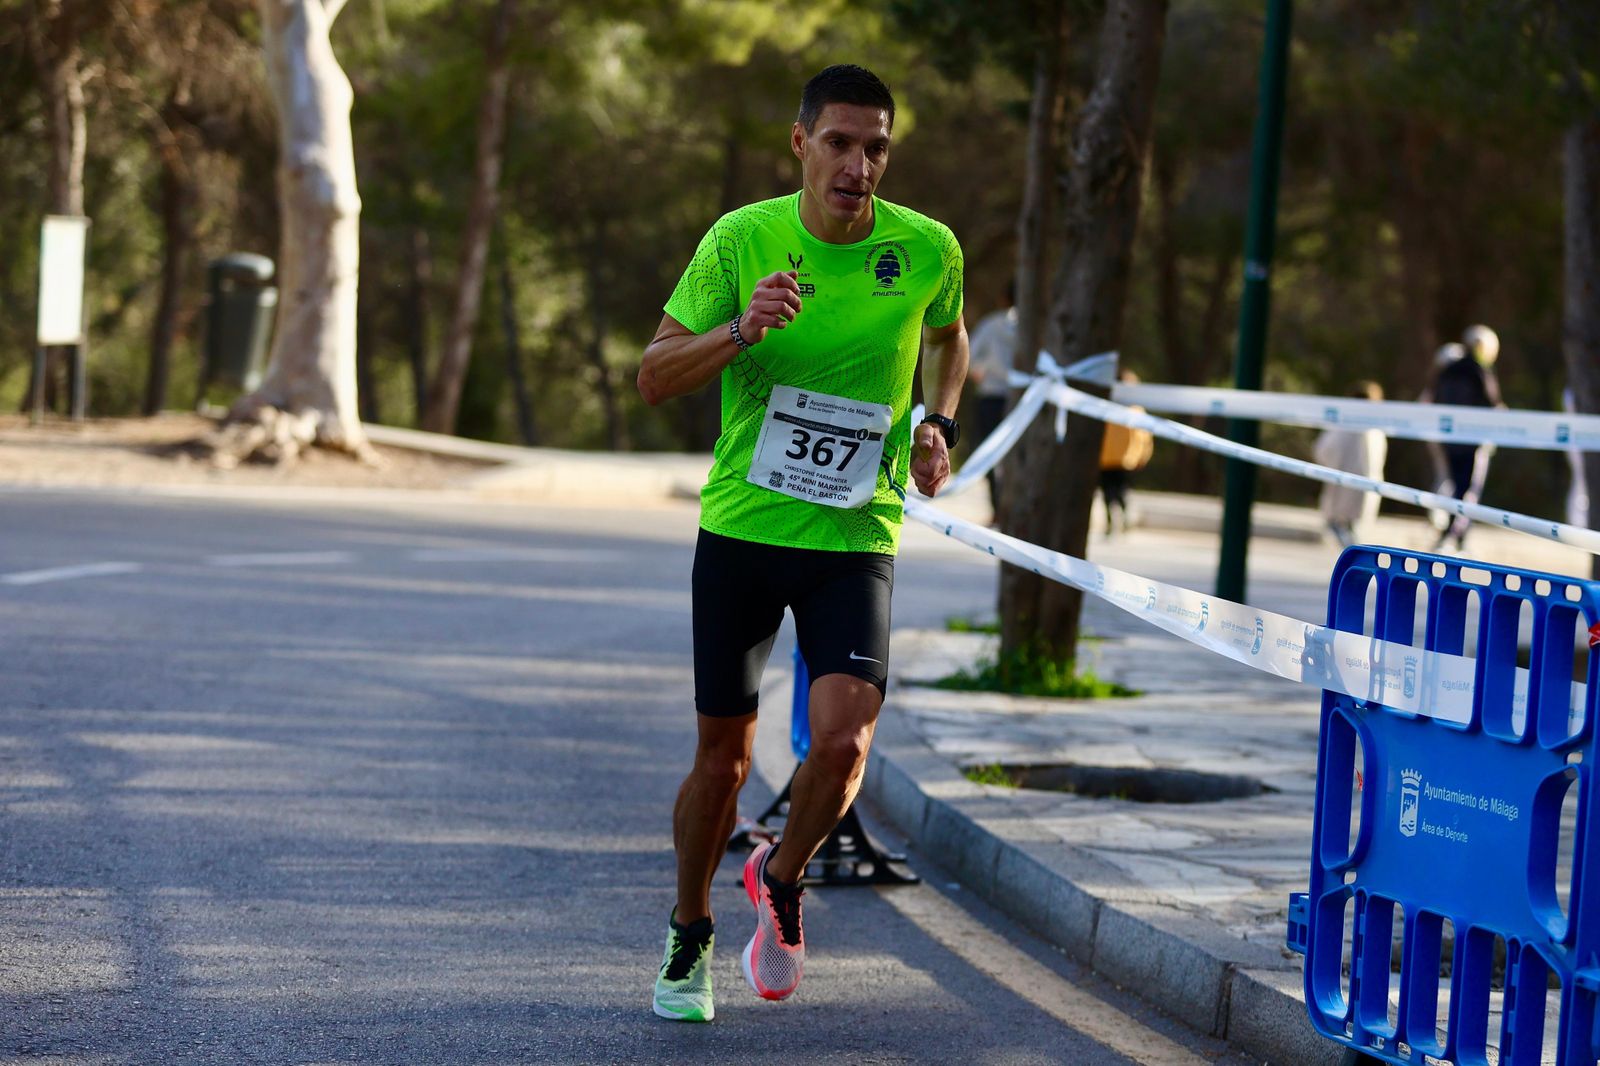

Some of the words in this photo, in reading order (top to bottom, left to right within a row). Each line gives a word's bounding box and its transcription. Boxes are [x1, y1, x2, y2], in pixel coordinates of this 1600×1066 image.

[809, 399, 847, 412] Ayuntamiento
[855, 408, 875, 418] Málaga
[785, 429, 861, 472] 367
[784, 464, 815, 477] CHRISTOPHE
[815, 472, 848, 484] PARMENTIER
[786, 482, 807, 494] PEÑA
[807, 488, 817, 497] EL
[818, 491, 849, 502] BASTÓN
[800, 477, 817, 487] MINI
[817, 481, 853, 493] MARATÓN
[1424, 781, 1477, 808] Ayuntamiento
[1478, 796, 1489, 811] de
[1489, 798, 1519, 821] Málaga
[1421, 818, 1436, 835] Área
[1435, 825, 1445, 837] de
[1445, 827, 1469, 843] Deporte
